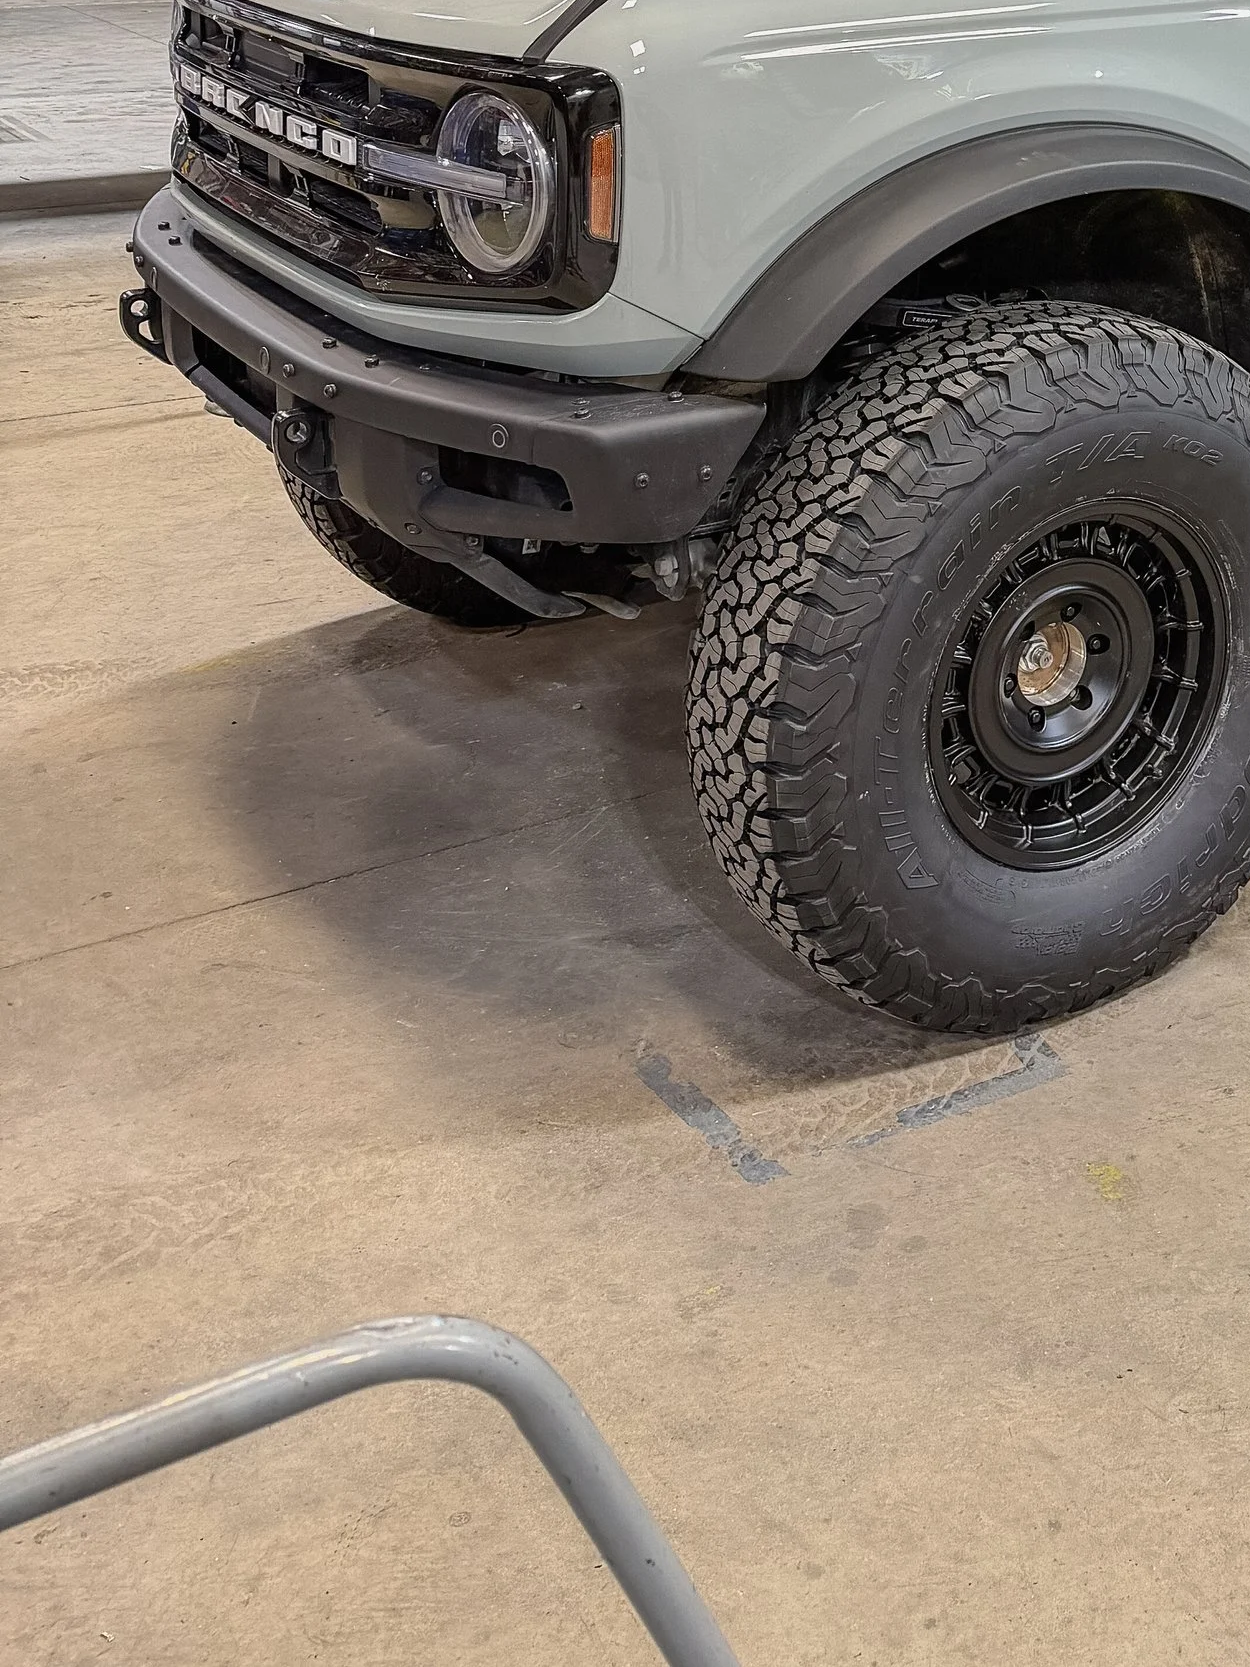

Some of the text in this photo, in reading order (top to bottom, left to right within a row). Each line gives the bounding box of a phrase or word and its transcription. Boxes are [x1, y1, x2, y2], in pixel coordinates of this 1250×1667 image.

[180, 63, 357, 166] BRONCO
[1046, 431, 1151, 483] T/A
[1162, 433, 1225, 468] KO2
